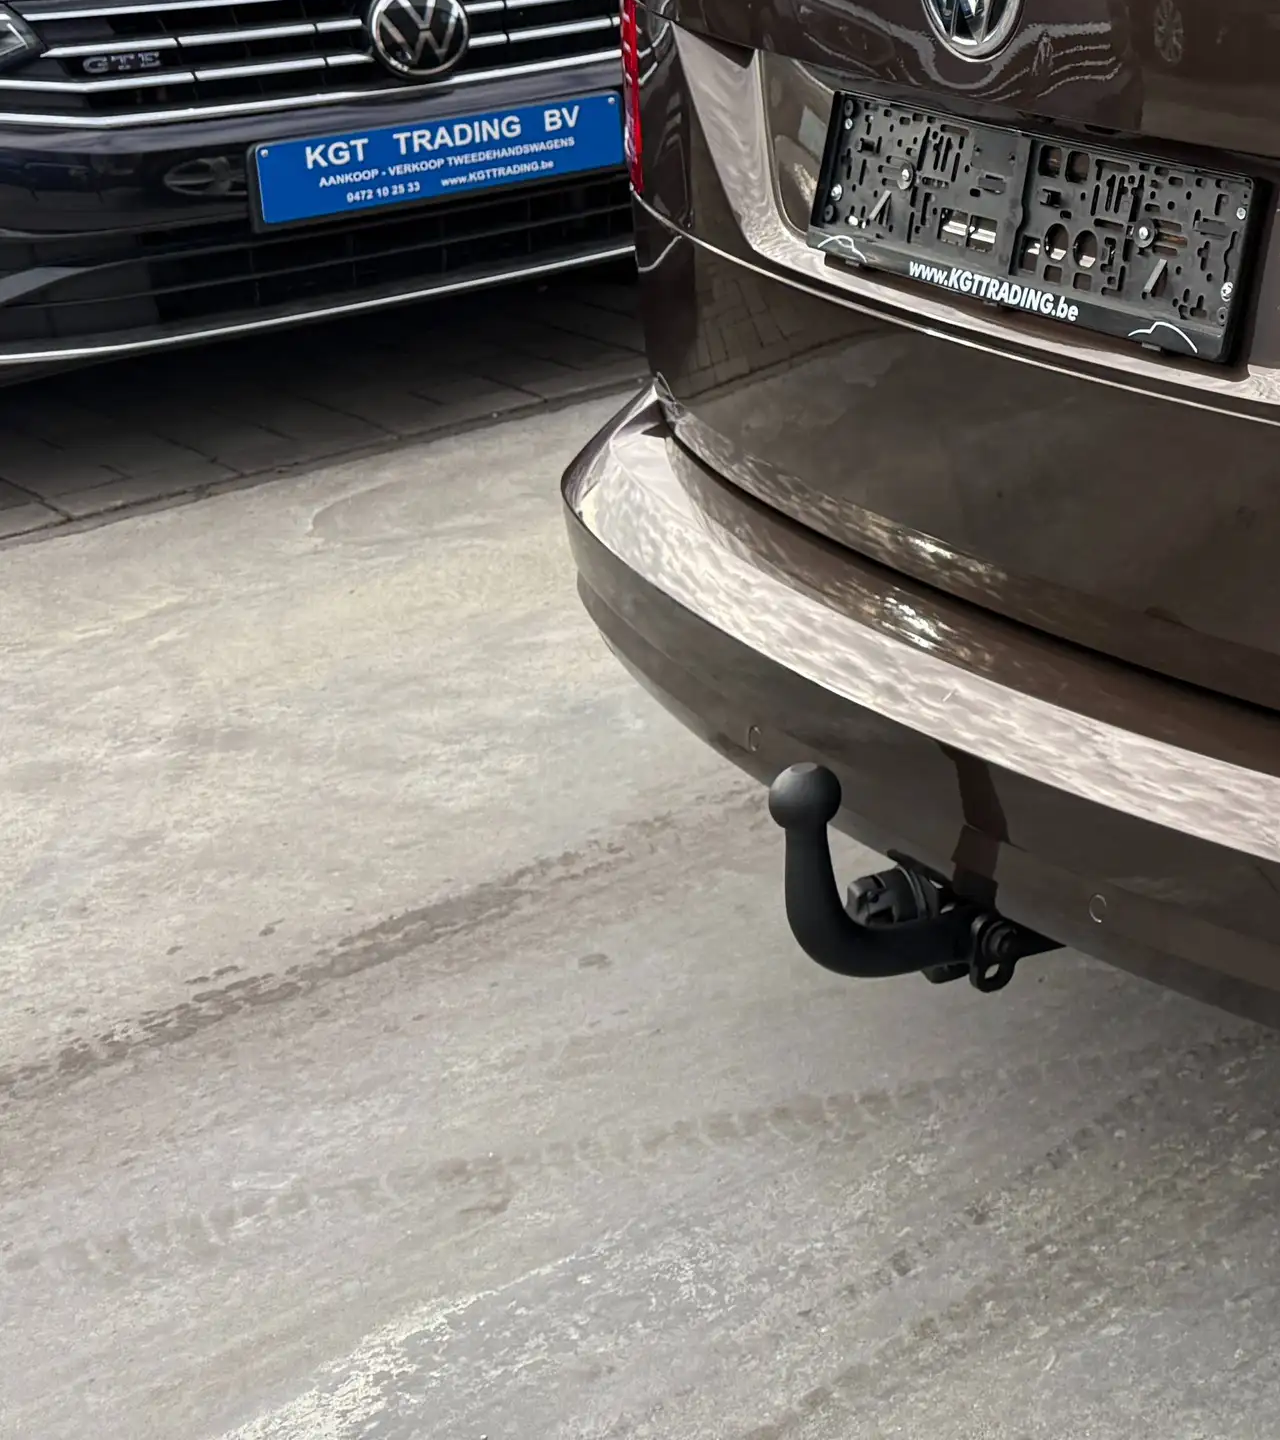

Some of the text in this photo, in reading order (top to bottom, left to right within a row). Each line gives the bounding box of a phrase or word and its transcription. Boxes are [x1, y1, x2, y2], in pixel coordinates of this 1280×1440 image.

[82, 51, 160, 73] GTE
[305, 105, 580, 169] KGT TRADING BV
[319, 169, 379, 188] AANKOOP
[388, 158, 444, 177] VERKOOP
[446, 136, 575, 167] TWEEDEHANDSWAGENS
[346, 188, 374, 203] 0472
[376, 186, 389, 198] 10
[407, 181, 420, 193] 33
[441, 160, 554, 186] www.KGTTRADING.be
[908, 261, 1079, 323] www.KGTTRADING.be
